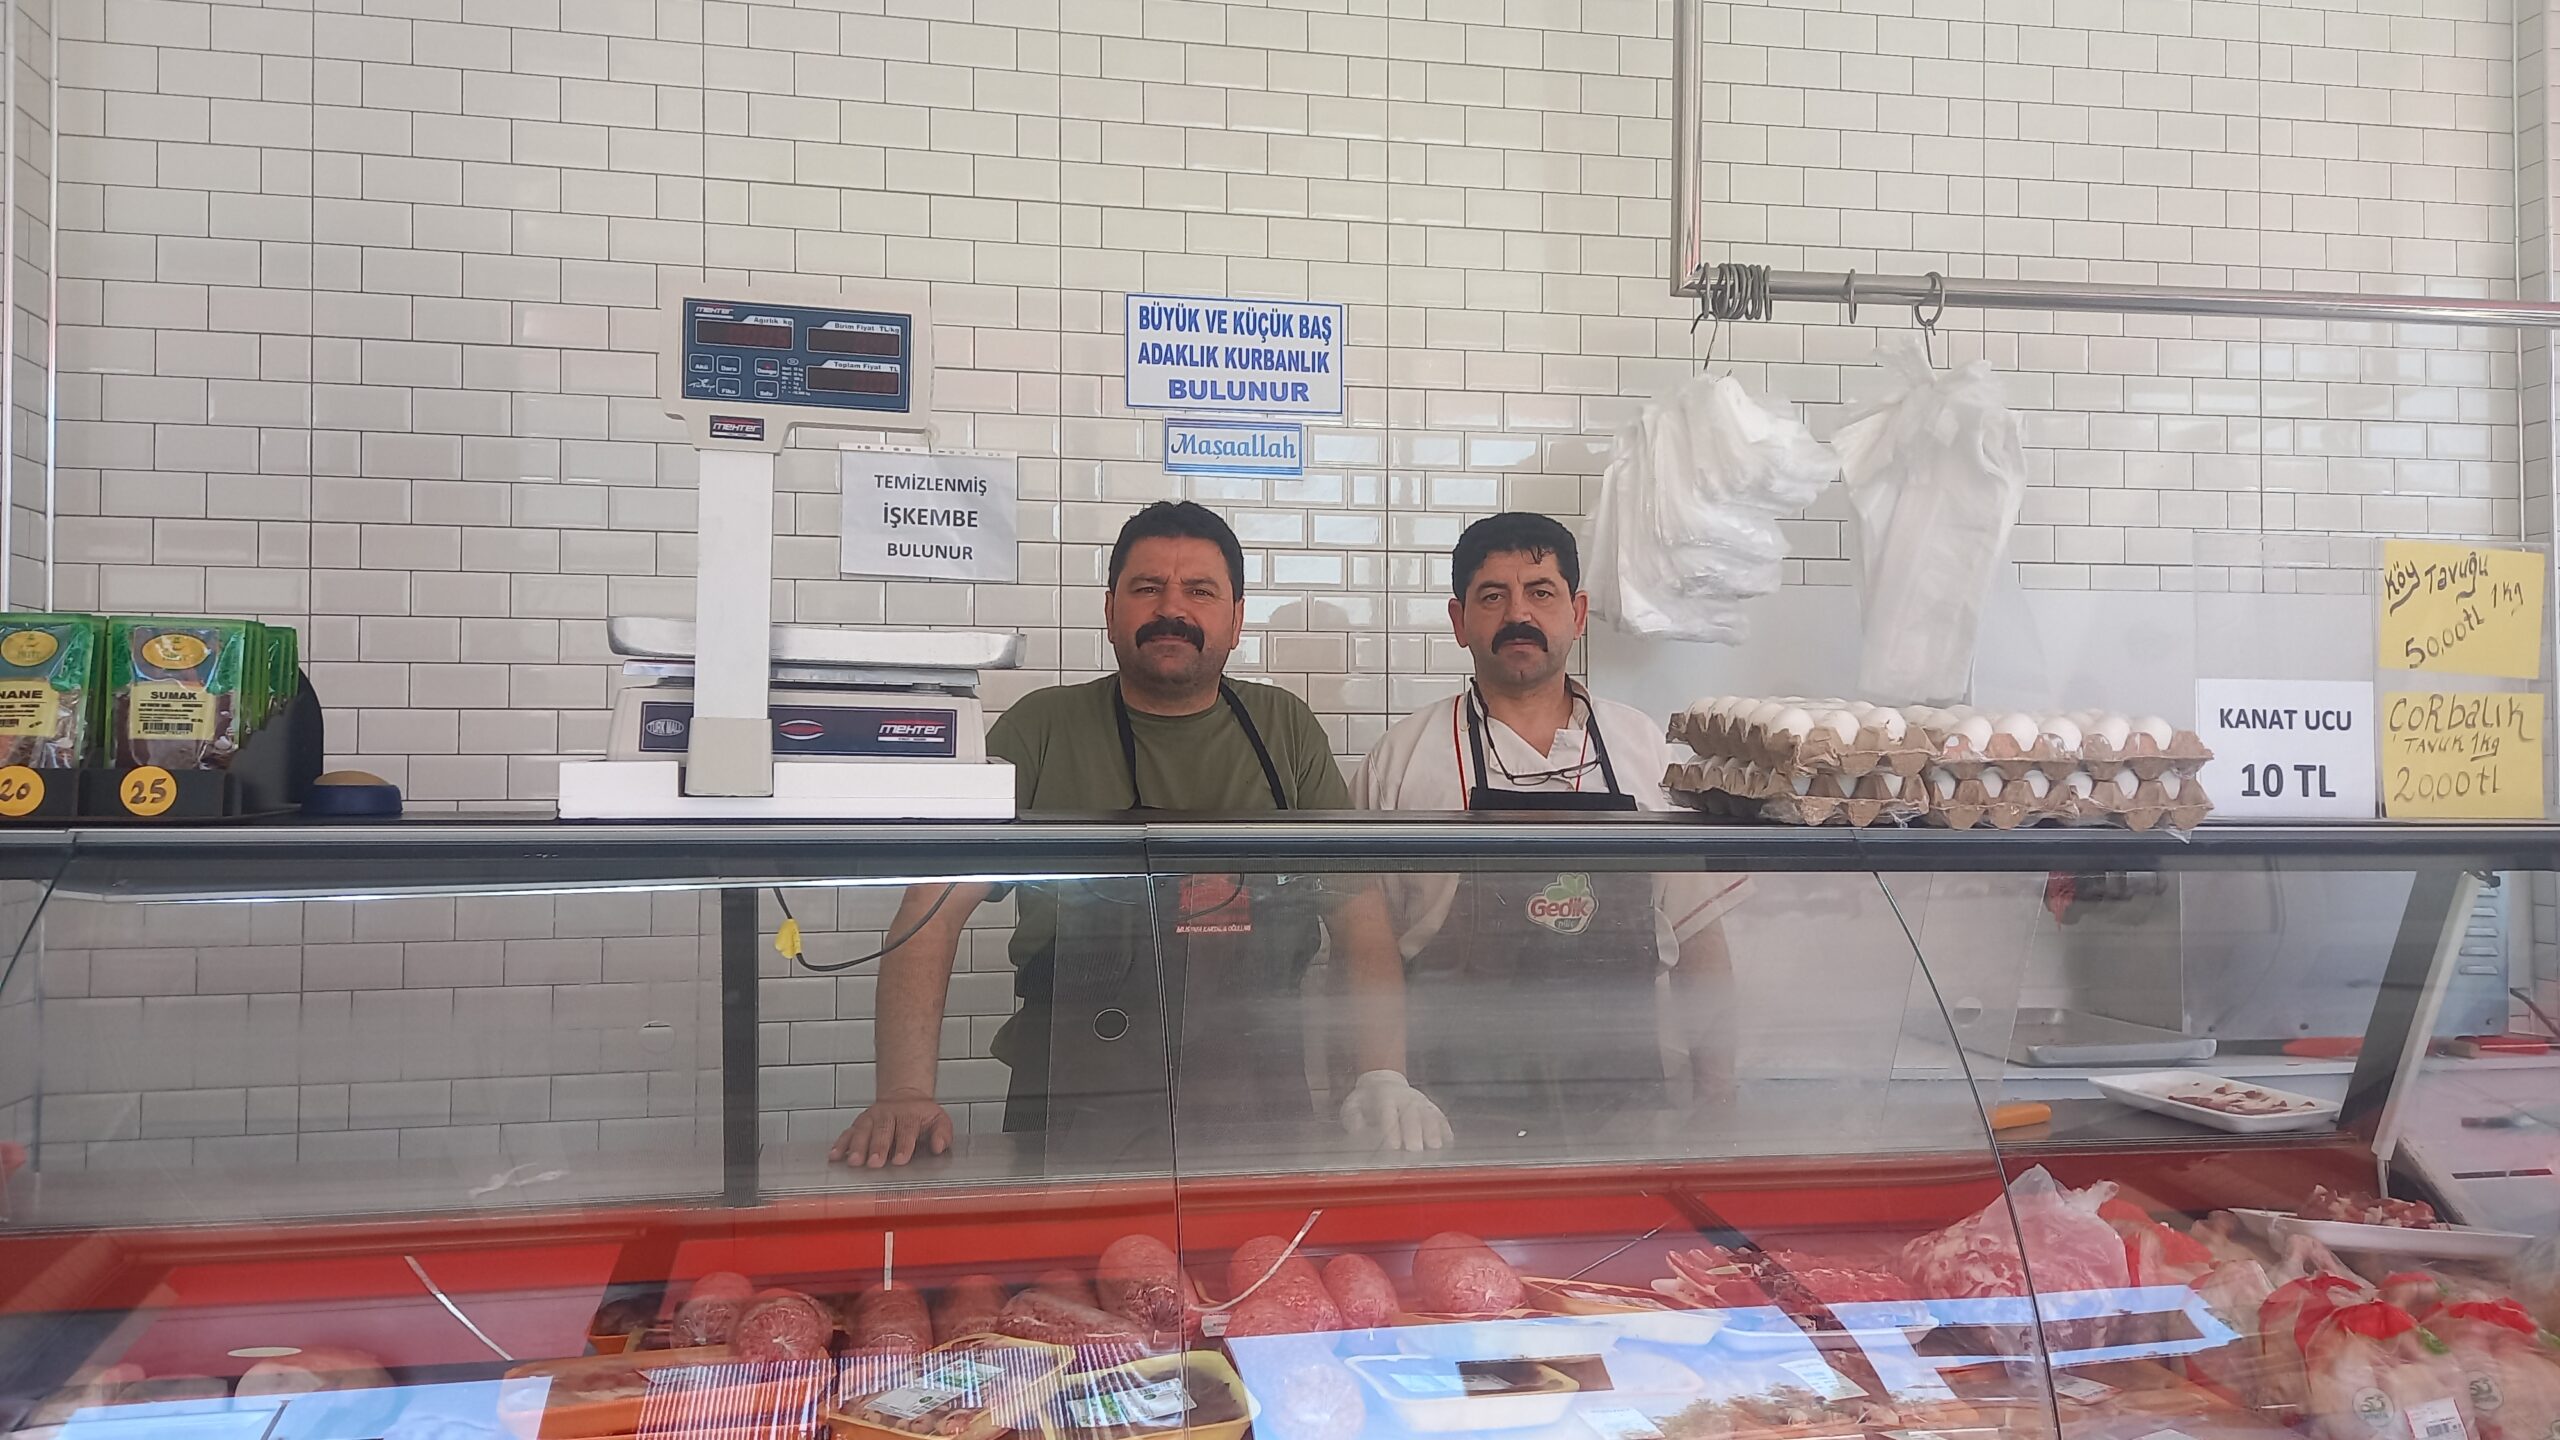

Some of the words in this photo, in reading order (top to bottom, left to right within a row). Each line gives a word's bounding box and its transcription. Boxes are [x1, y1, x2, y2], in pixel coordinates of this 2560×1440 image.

[834, 322, 855, 331] Birim
[856, 324, 874, 332] Fiyat
[1139, 301, 1200, 332] BÜYÜK
[1205, 308, 1228, 334] VE
[1233, 307, 1294, 343] KÜÇÜK
[1300, 314, 1332, 346] BAŞ
[834, 361, 860, 370] Toplam
[862, 363, 881, 371] Fiyat
[1138, 342, 1218, 368] ADAKLIK
[1224, 346, 1330, 373] KURBANLIK
[1168, 379, 1310, 402] BULUNUR
[1171, 433, 1296, 460] Maşaallah
[874, 473, 987, 496] TEMİZLENMİŞ
[883, 502, 978, 528] İŞKEMBE
[887, 543, 974, 560] BULUNUR
[150, 691, 197, 700] SUMAK
[2219, 708, 2297, 730] KANAT
[2304, 710, 2352, 731] UCU
[2404, 736, 2465, 755] TAVUK
[0, 777, 31, 802] 20
[130, 777, 167, 805] 25
[2241, 764, 2284, 798] 10
[2294, 764, 2336, 798] TL
[1530, 897, 1589, 918] Gedik
